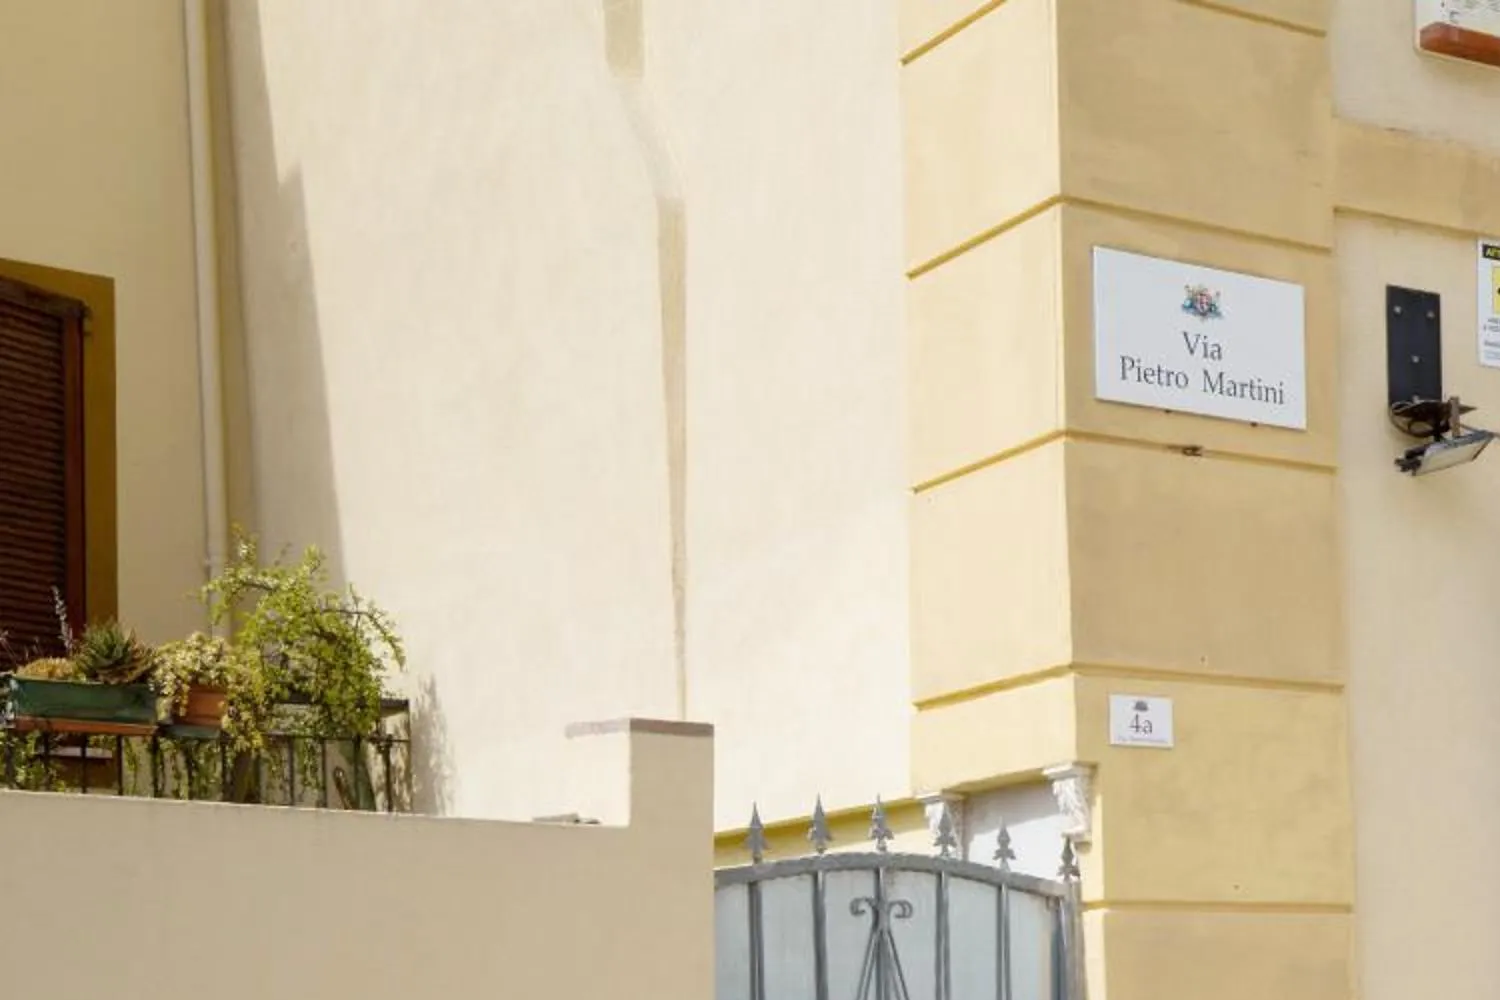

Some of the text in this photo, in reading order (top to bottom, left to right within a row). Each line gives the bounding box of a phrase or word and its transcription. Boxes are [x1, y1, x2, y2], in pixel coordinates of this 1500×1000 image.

[1182, 331, 1223, 361] Via
[1119, 355, 1285, 405] Pietro Martini
[1129, 713, 1153, 734] 4a
